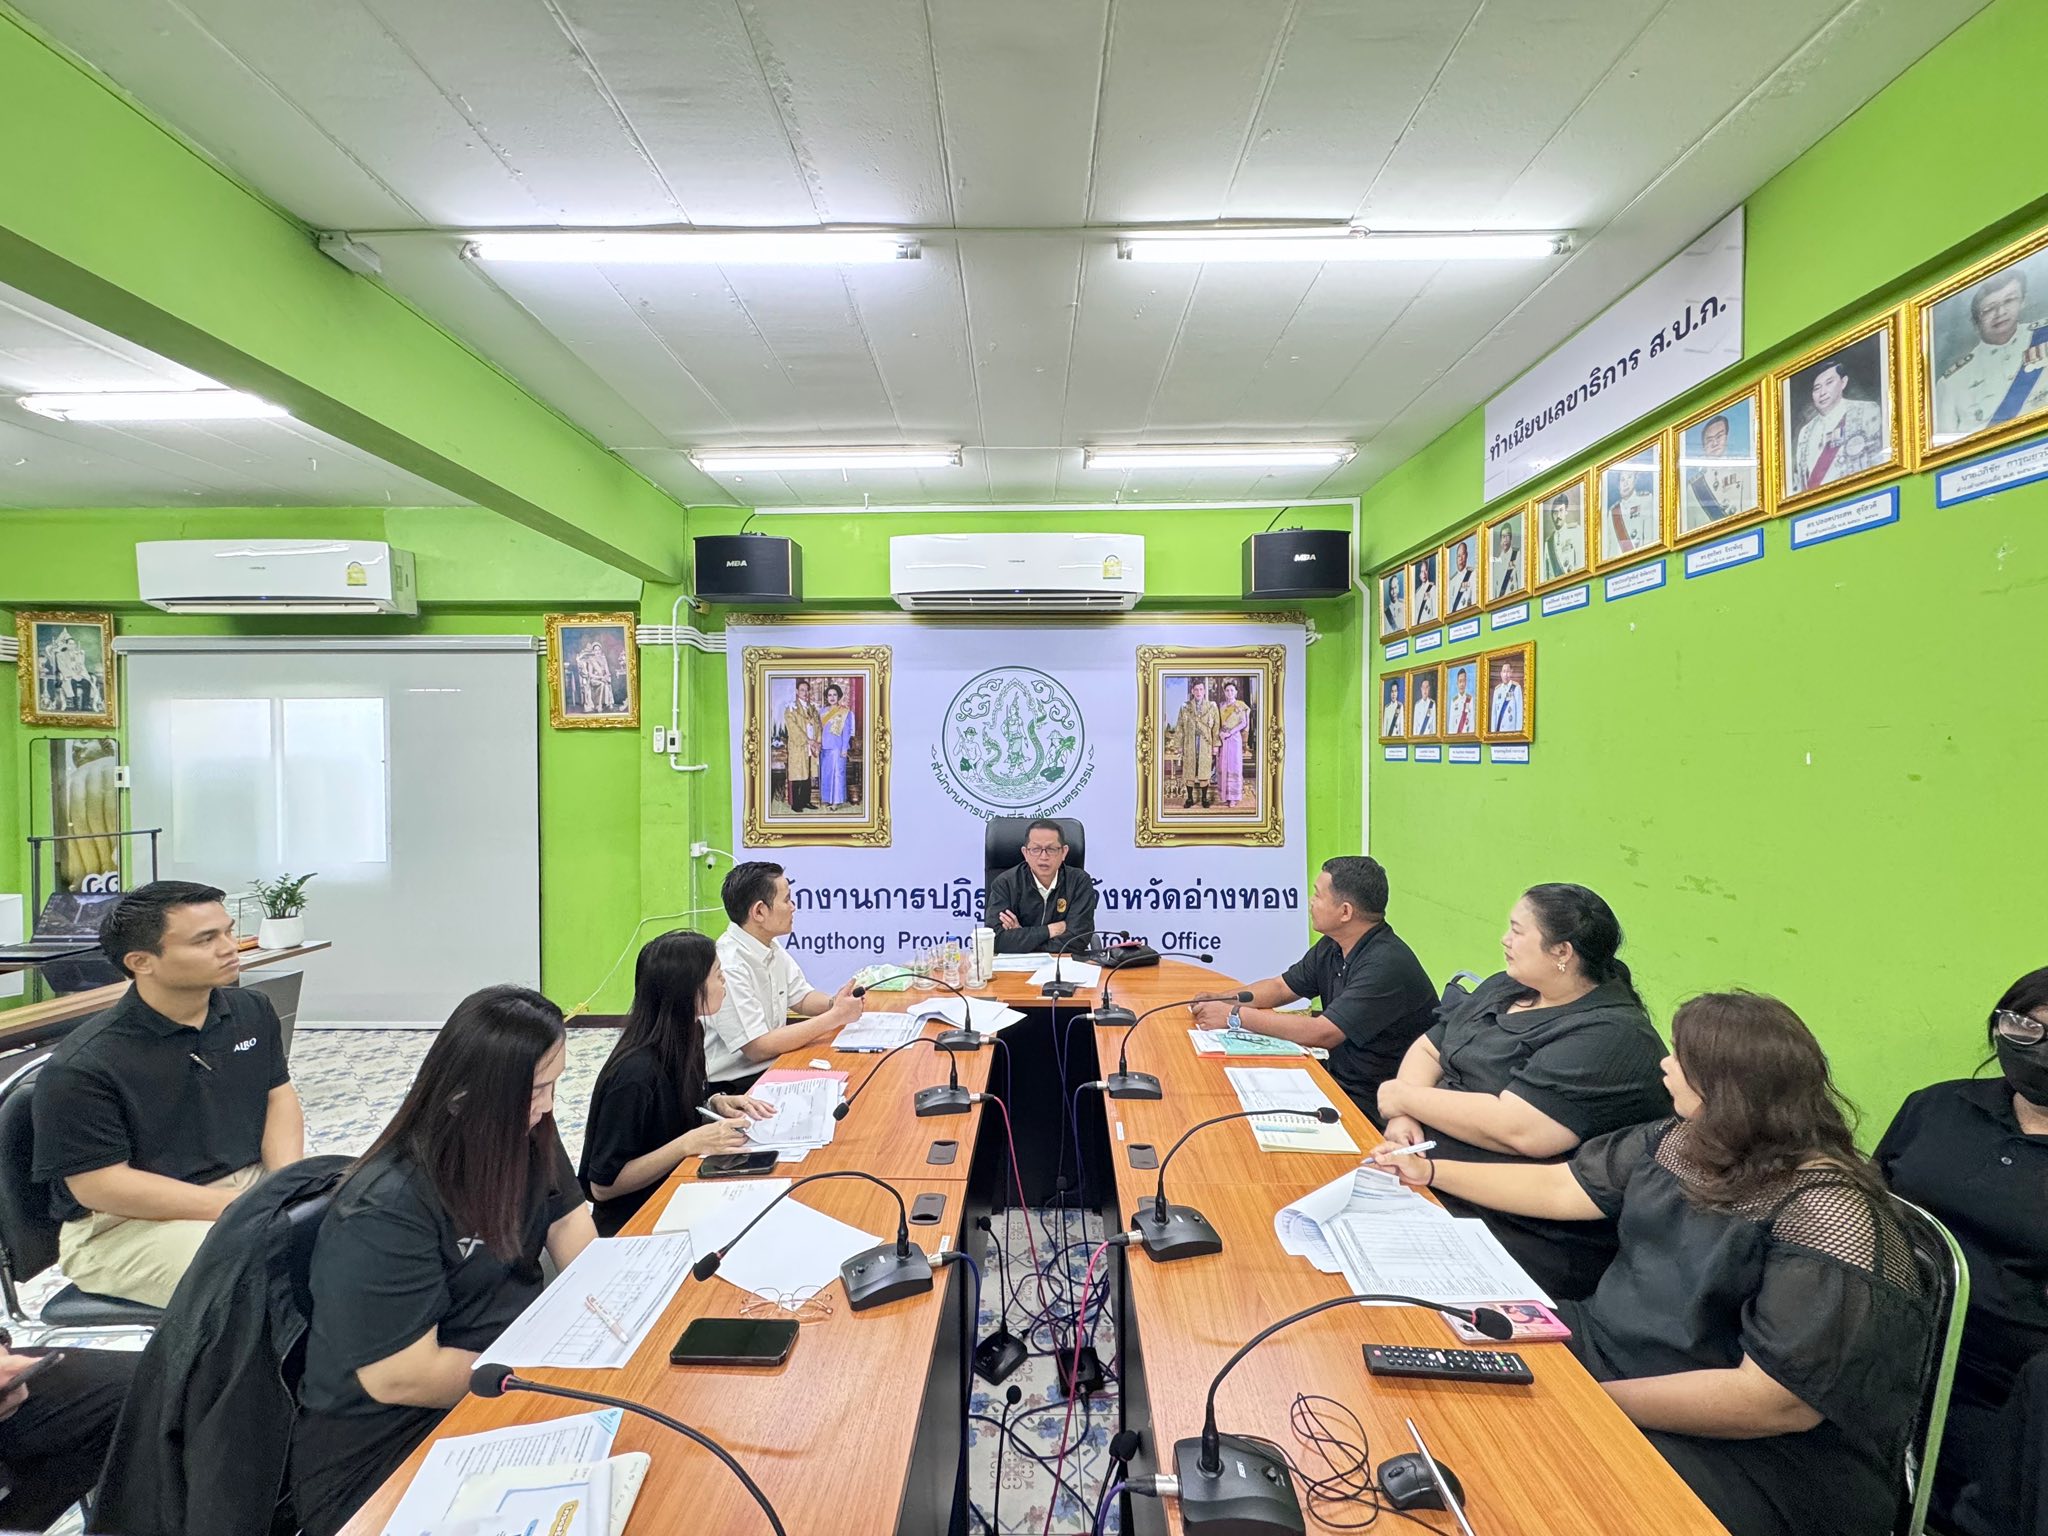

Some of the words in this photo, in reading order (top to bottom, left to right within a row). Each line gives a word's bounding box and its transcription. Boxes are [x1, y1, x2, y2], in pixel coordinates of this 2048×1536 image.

[1489, 348, 1642, 462] ทำเนียบเลขาธิการ
[1649, 296, 1727, 359] ส.ป.ก.
[785, 931, 885, 954] Angthong
[898, 931, 974, 950] Provinc
[1161, 931, 1222, 950] Office
